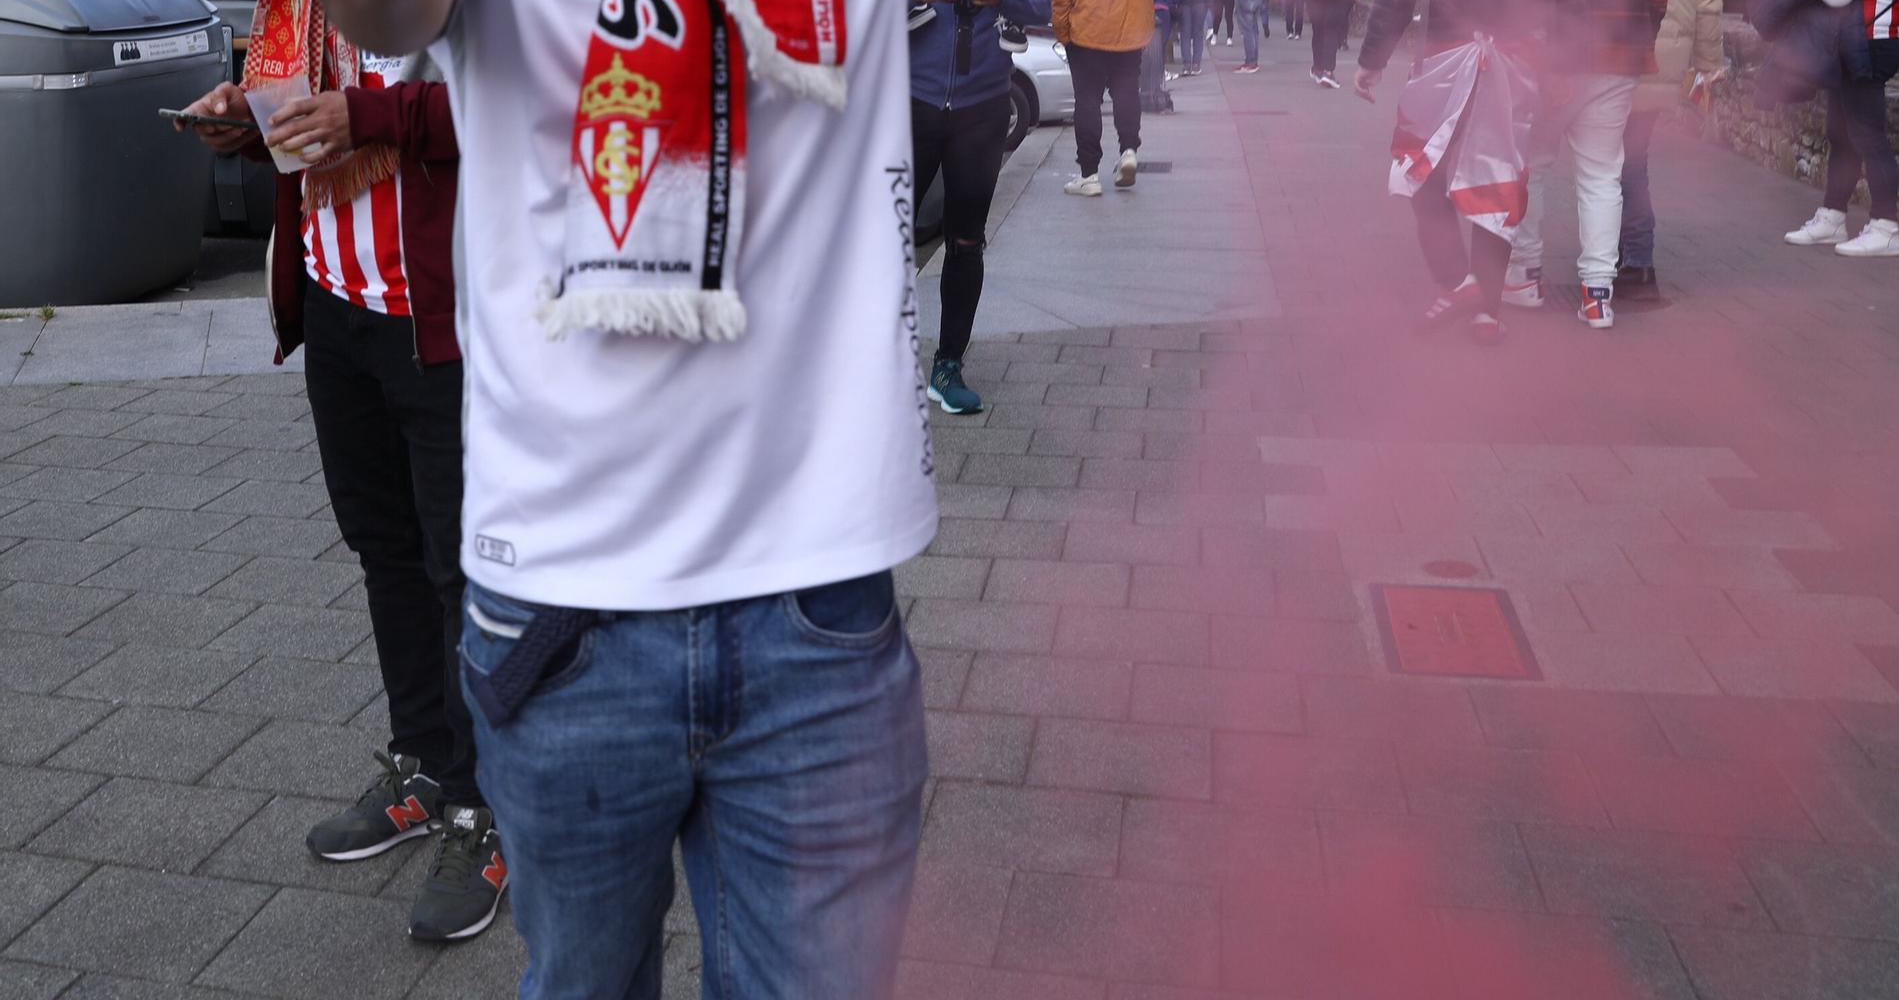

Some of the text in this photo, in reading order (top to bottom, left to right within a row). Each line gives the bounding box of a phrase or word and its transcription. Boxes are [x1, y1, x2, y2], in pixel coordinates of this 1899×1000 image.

[262, 58, 285, 76] REAL
[713, 89, 728, 114] DE
[712, 117, 729, 215] SPORTING
[707, 219, 725, 267] REAL
